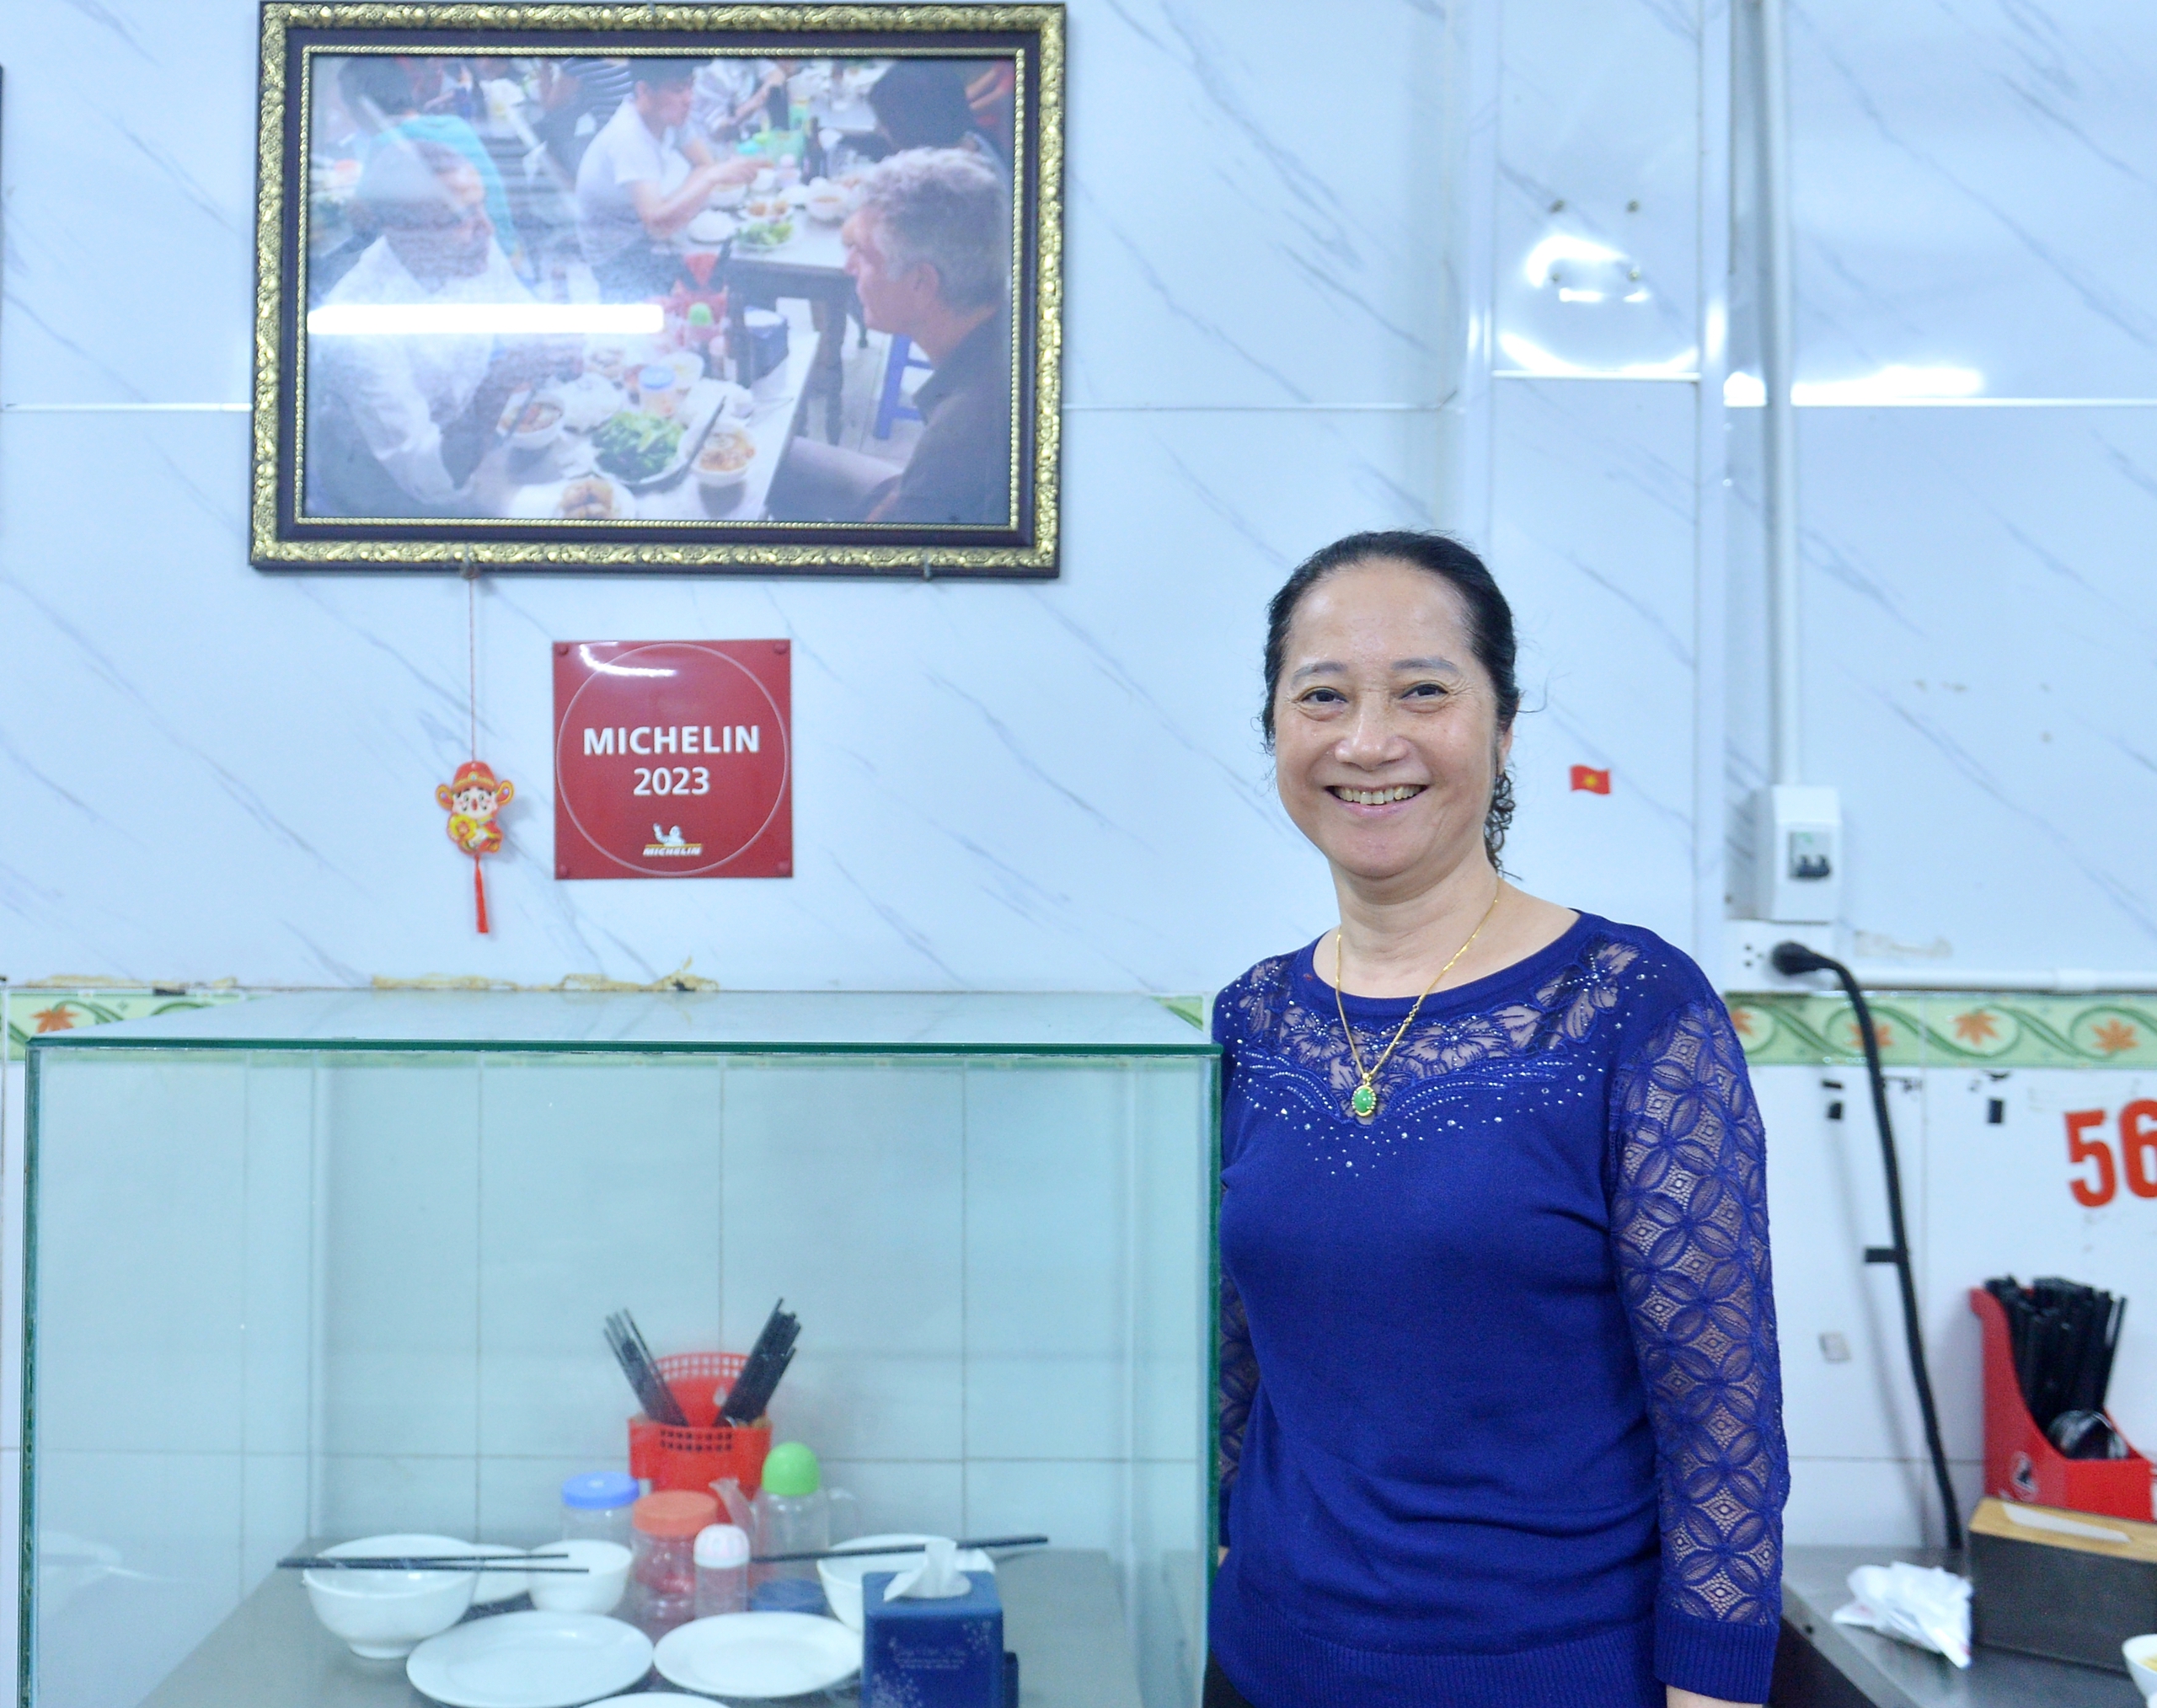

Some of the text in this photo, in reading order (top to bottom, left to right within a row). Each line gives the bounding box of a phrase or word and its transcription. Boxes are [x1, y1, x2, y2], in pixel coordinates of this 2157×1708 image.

[583, 725, 759, 755] MICHELIN
[633, 766, 710, 796] 2023
[643, 846, 702, 856] MICHELIN
[2063, 1099, 2157, 1210] 56
